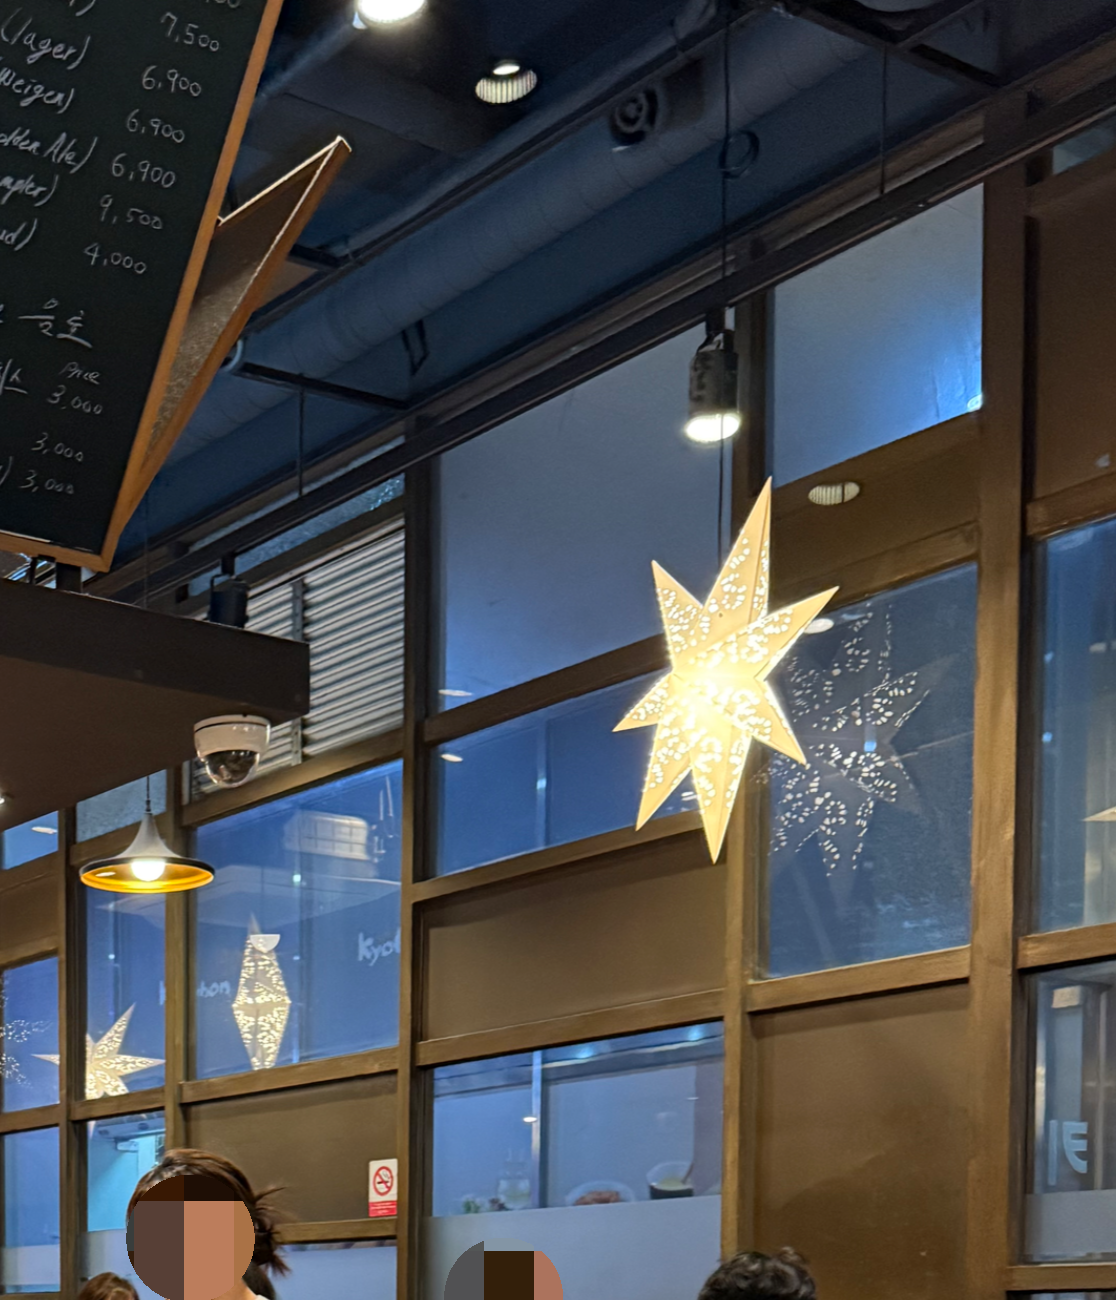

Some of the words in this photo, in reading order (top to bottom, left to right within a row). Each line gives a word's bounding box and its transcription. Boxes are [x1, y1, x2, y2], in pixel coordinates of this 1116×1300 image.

[160, 11, 220, 51] 7,500
[142, 65, 202, 97] 6,900
[126, 108, 185, 143] 6,900
[111, 152, 177, 188] 6,900
[99, 194, 163, 230] 9,500
[84, 242, 147, 274] 4,000
[47, 384, 103, 415] 3,000
[32, 431, 85, 462] 3,000
[20, 470, 75, 495] 3,000
